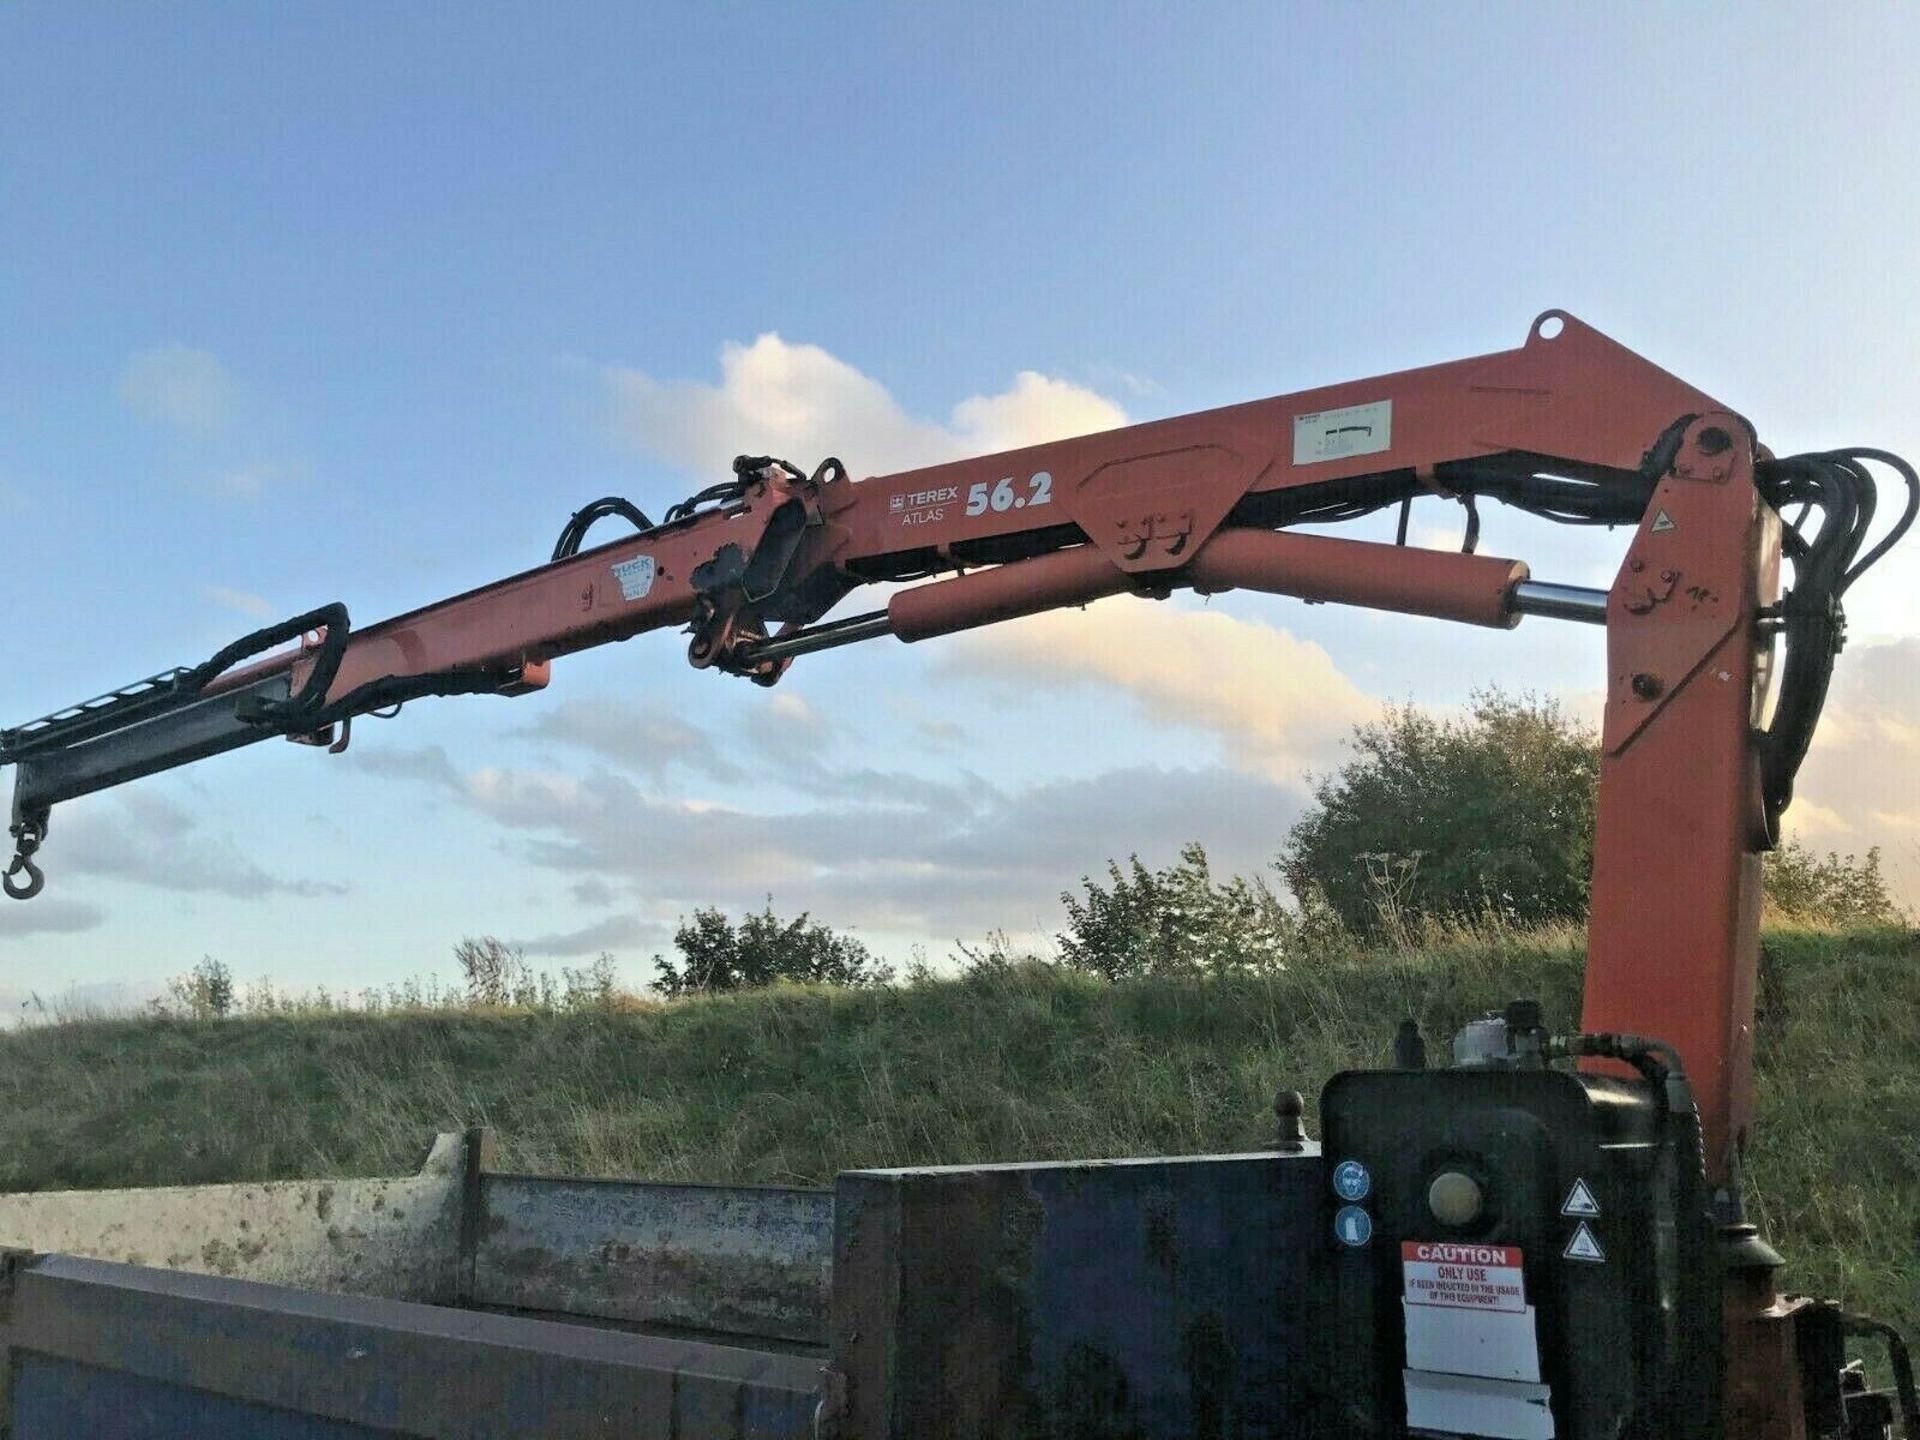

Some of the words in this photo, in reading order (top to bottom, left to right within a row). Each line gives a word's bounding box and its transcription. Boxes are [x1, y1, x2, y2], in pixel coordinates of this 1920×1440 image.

[907, 486, 959, 506] TEREX
[965, 471, 1052, 516] 56.2
[901, 508, 944, 526] ATLAS
[1417, 1245, 1506, 1264] CAUTION
[1438, 1266, 1464, 1280] ONLY
[1466, 1268, 1487, 1282] USE
[1416, 1279, 1434, 1290] BEEN
[1480, 1284, 1494, 1294] THE
[1496, 1285, 1520, 1296] USAGE
[1429, 1290, 1438, 1300] OF
[1440, 1291, 1455, 1301] THIS
